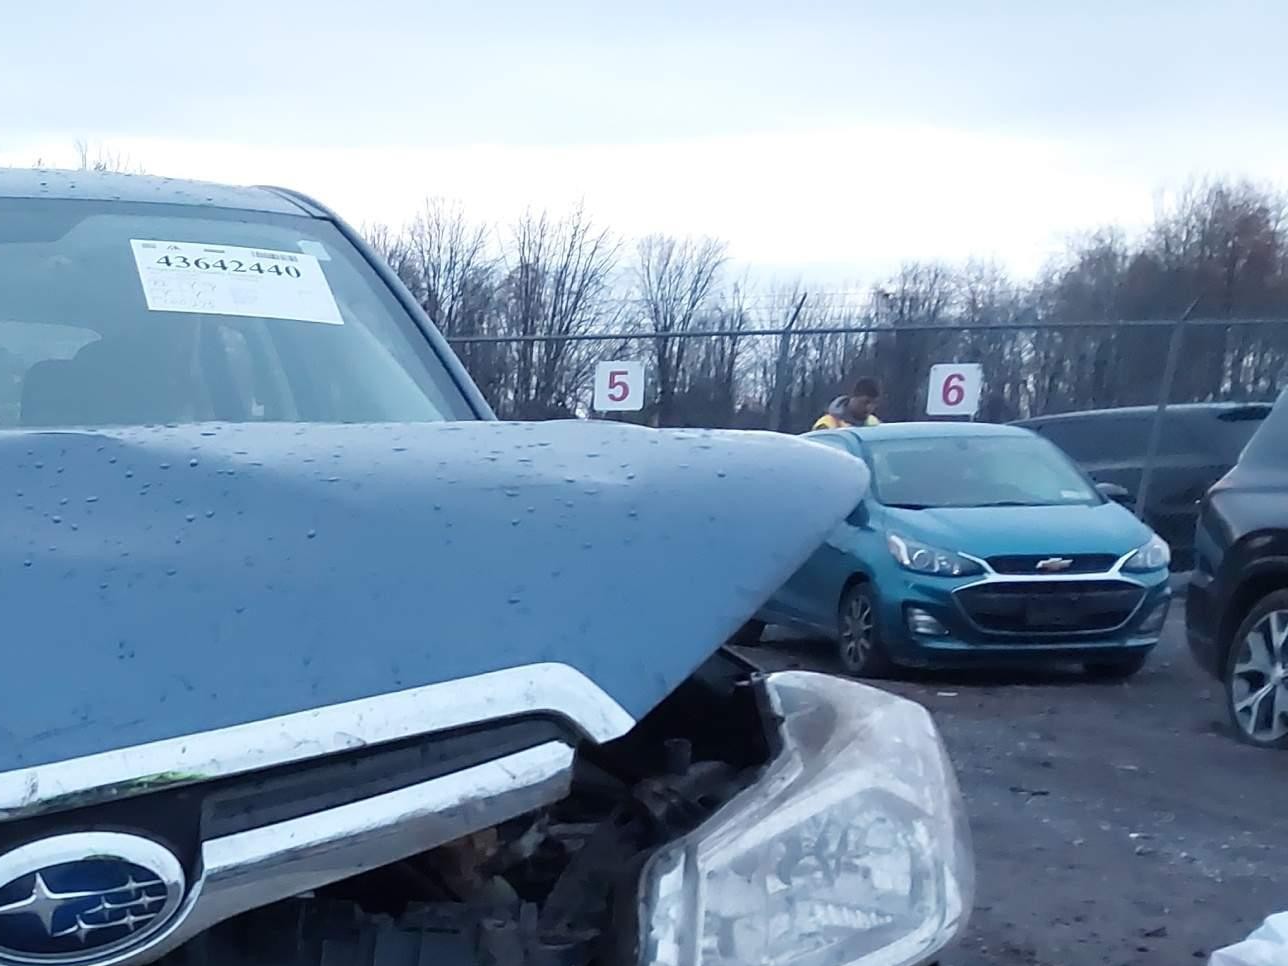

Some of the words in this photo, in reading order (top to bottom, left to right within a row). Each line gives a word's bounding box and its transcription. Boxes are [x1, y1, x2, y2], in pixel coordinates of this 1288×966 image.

[155, 254, 302, 279] 43642440
[606, 370, 630, 402] 5
[941, 373, 966, 407] 6
